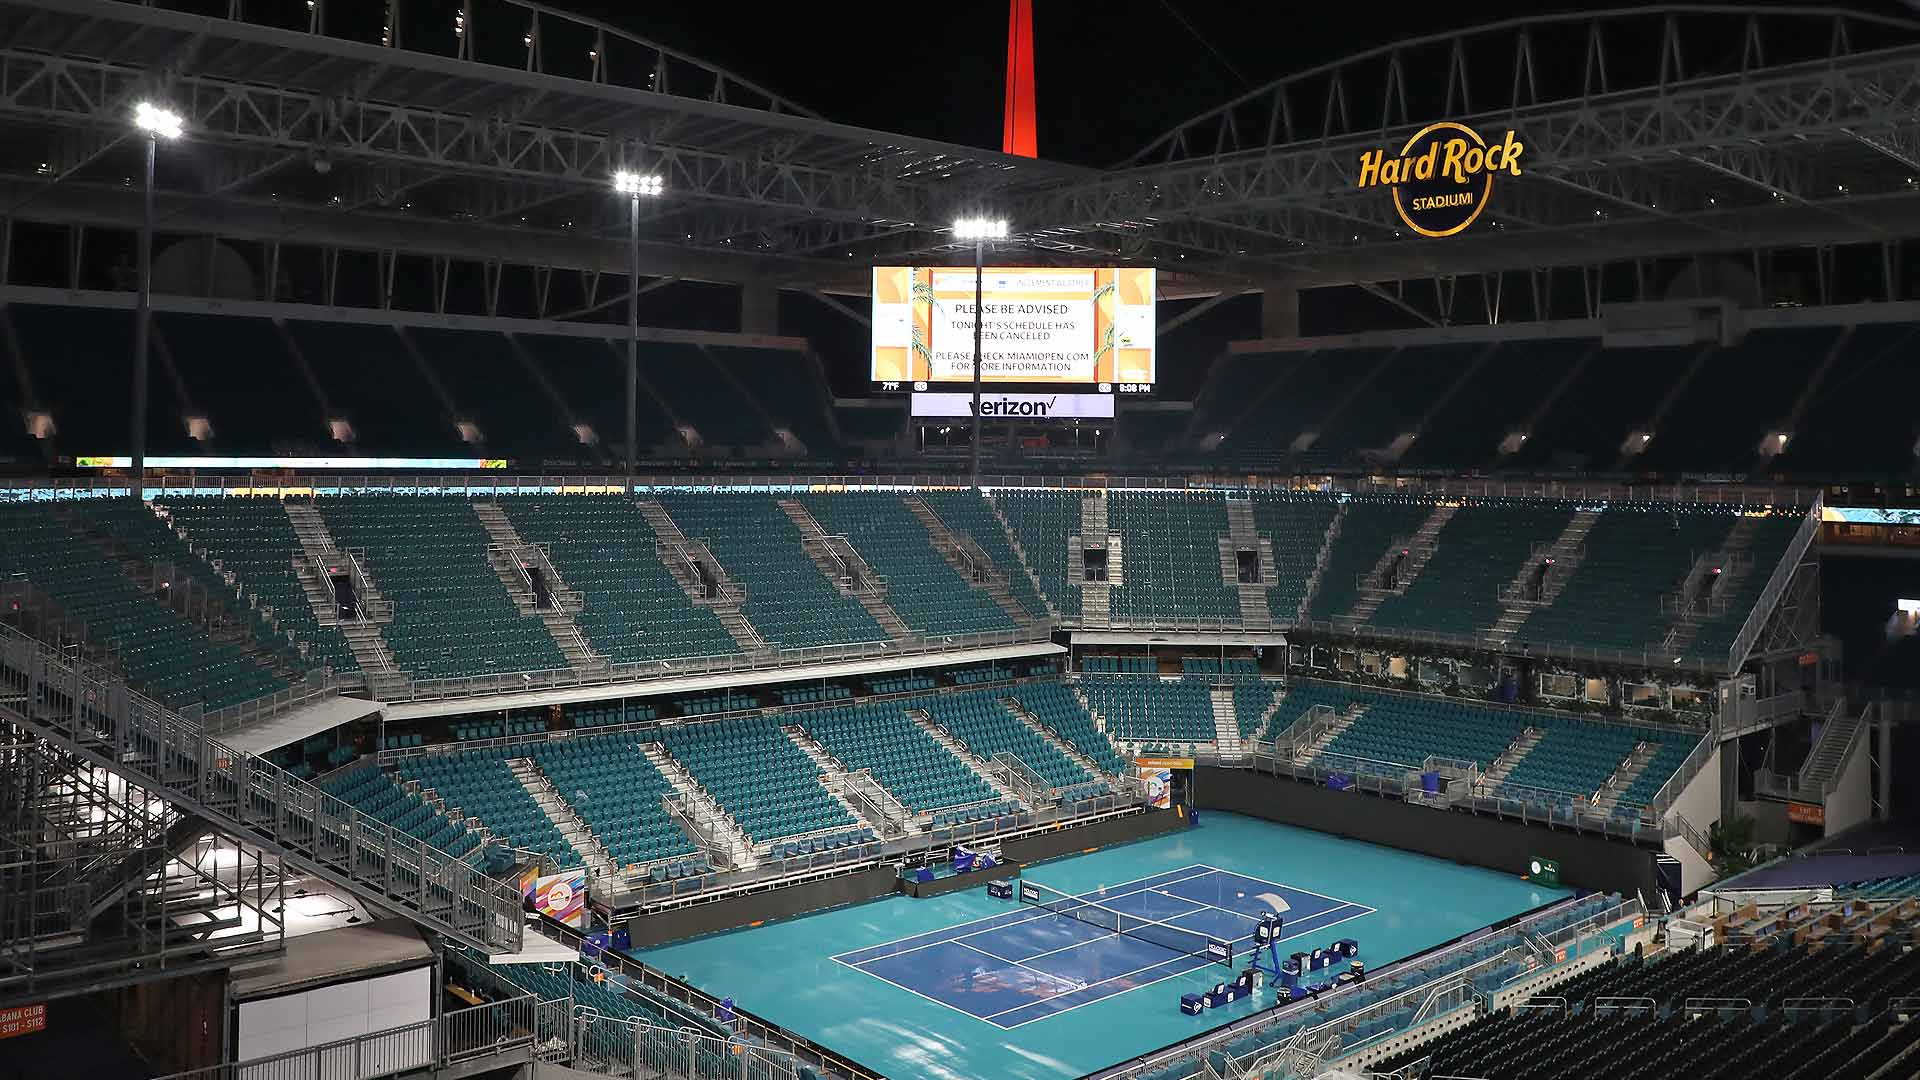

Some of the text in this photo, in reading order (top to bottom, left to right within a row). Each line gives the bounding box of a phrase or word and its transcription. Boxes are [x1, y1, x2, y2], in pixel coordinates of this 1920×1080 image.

[1357, 130, 1524, 188] Hard Rock
[1412, 193, 1473, 211] STADIUM
[1000, 304, 1015, 314] BE
[1017, 304, 1069, 314] ADVISED
[950, 321, 1075, 330] TONIHT'S SCHEDULE HAS
[973, 332, 1051, 340] EEN CANCELED
[935, 351, 1089, 361] PLEASE HECK MIAMIOPENCOM
[951, 362, 1071, 372] FOR ORE INFORMATION
[1138, 383, 1151, 392] PM
[0, 1007, 43, 1023] BANA CLUB
